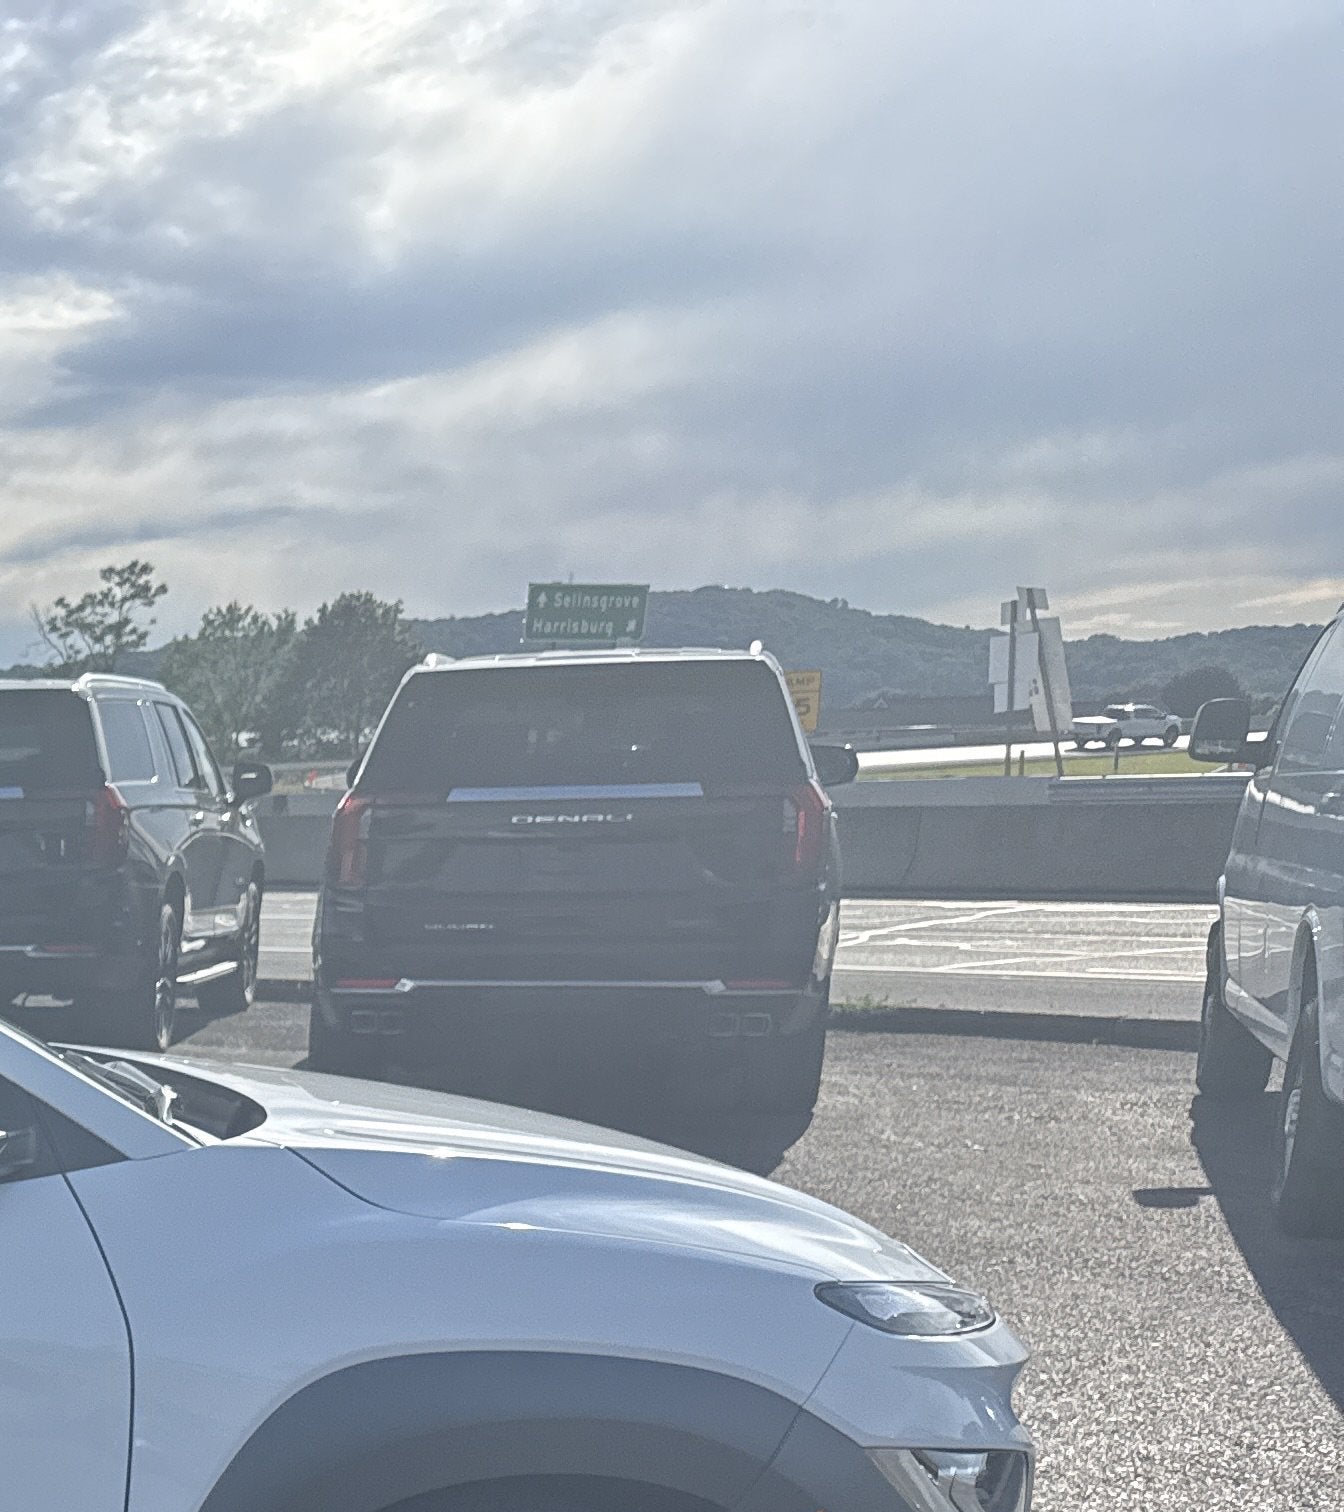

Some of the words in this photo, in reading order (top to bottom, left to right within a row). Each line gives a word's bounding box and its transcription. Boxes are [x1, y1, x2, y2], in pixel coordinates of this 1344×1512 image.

[553, 591, 640, 612] Selinsgrove
[532, 618, 614, 637] Harrisburg
[786, 677, 816, 688] AMP
